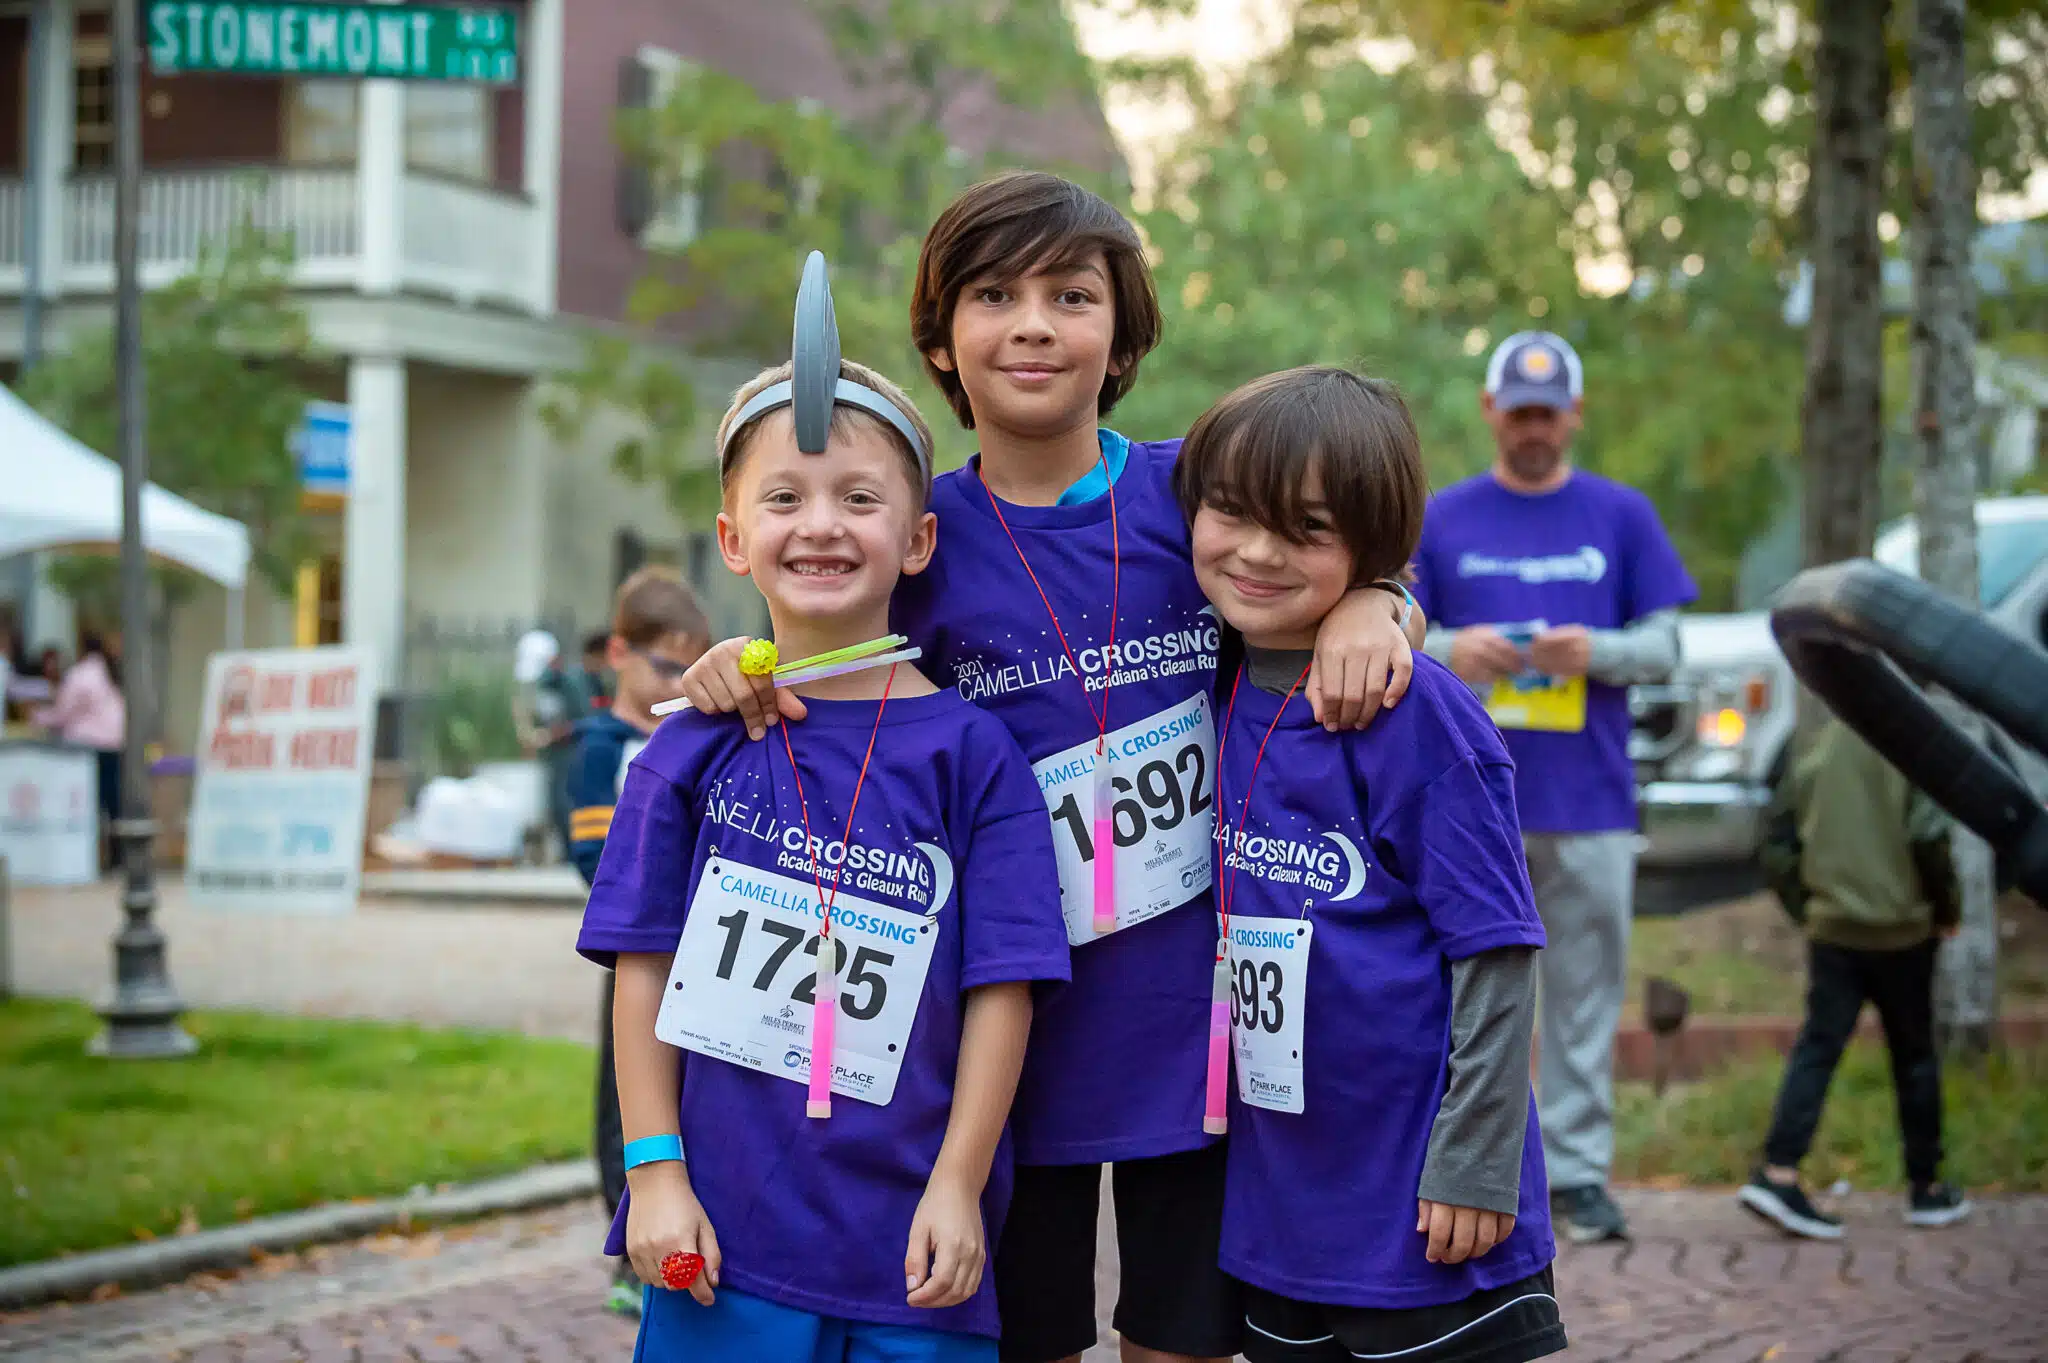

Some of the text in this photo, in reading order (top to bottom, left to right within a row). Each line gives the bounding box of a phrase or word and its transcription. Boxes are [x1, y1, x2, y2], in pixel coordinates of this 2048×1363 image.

[152, 2, 431, 73] STONEMONT
[954, 659, 985, 679] 2021
[958, 627, 1219, 702] CAMELLIA CROSSING
[1084, 653, 1218, 692] Acadiana's Gleaux Ru
[1122, 708, 1203, 757] CROSSING
[1051, 743, 1213, 863] 1692
[783, 827, 929, 888] CROSSING
[1234, 831, 1340, 876] ROSSING
[777, 850, 928, 907] Acadiana's Gleaux Run
[1268, 865, 1302, 883] Gleaux
[1304, 871, 1333, 893] Run
[720, 875, 917, 945] CAMELLIA CROSSING
[1236, 929, 1294, 949] CROSSING
[716, 909, 895, 1021] 1725
[1230, 958, 1284, 1033] 693
[749, 1057, 762, 1067] 1725
[835, 1065, 875, 1085] PLACE
[1256, 1080, 1292, 1094] PARK PLACE
